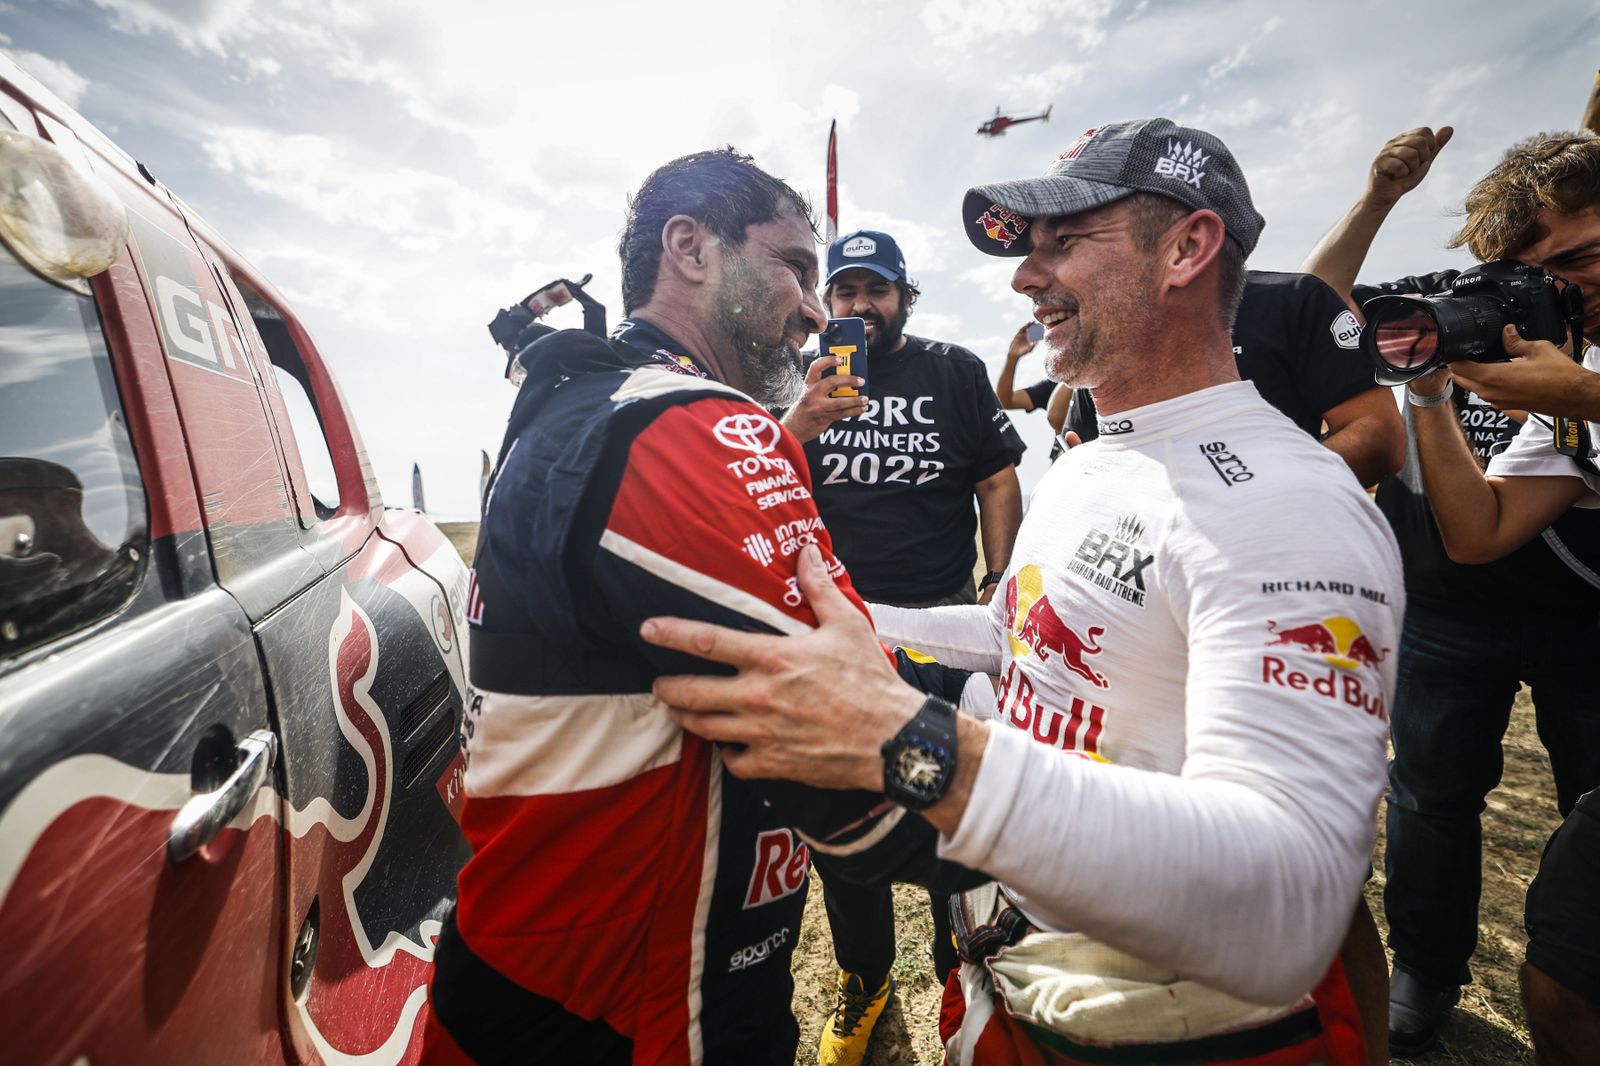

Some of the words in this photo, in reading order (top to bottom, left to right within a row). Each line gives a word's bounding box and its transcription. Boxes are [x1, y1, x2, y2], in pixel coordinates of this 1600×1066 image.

[1154, 157, 1206, 189] BRX
[1005, 211, 1029, 235] Red
[1455, 275, 1482, 287] Nikon
[156, 275, 260, 380] GR
[1338, 325, 1363, 342] eur
[840, 396, 935, 427] 2RC
[1460, 409, 1510, 428] 2022
[819, 428, 941, 453] WINNERS
[1474, 431, 1504, 442] NAS
[822, 452, 945, 486] 2022
[745, 471, 799, 496] FINANC
[757, 486, 812, 511] SERVICE
[1075, 528, 1154, 592] BRX
[1066, 559, 1095, 582] BAHRAIN
[1094, 572, 1113, 590] RAID
[1112, 581, 1146, 608] XTREME
[1262, 580, 1354, 596] RICHARD
[1360, 588, 1390, 605] MIL
[1262, 656, 1336, 699] Red
[1342, 674, 1388, 722] Bul
[1010, 671, 1105, 754] Bull
[745, 829, 811, 908] Re
